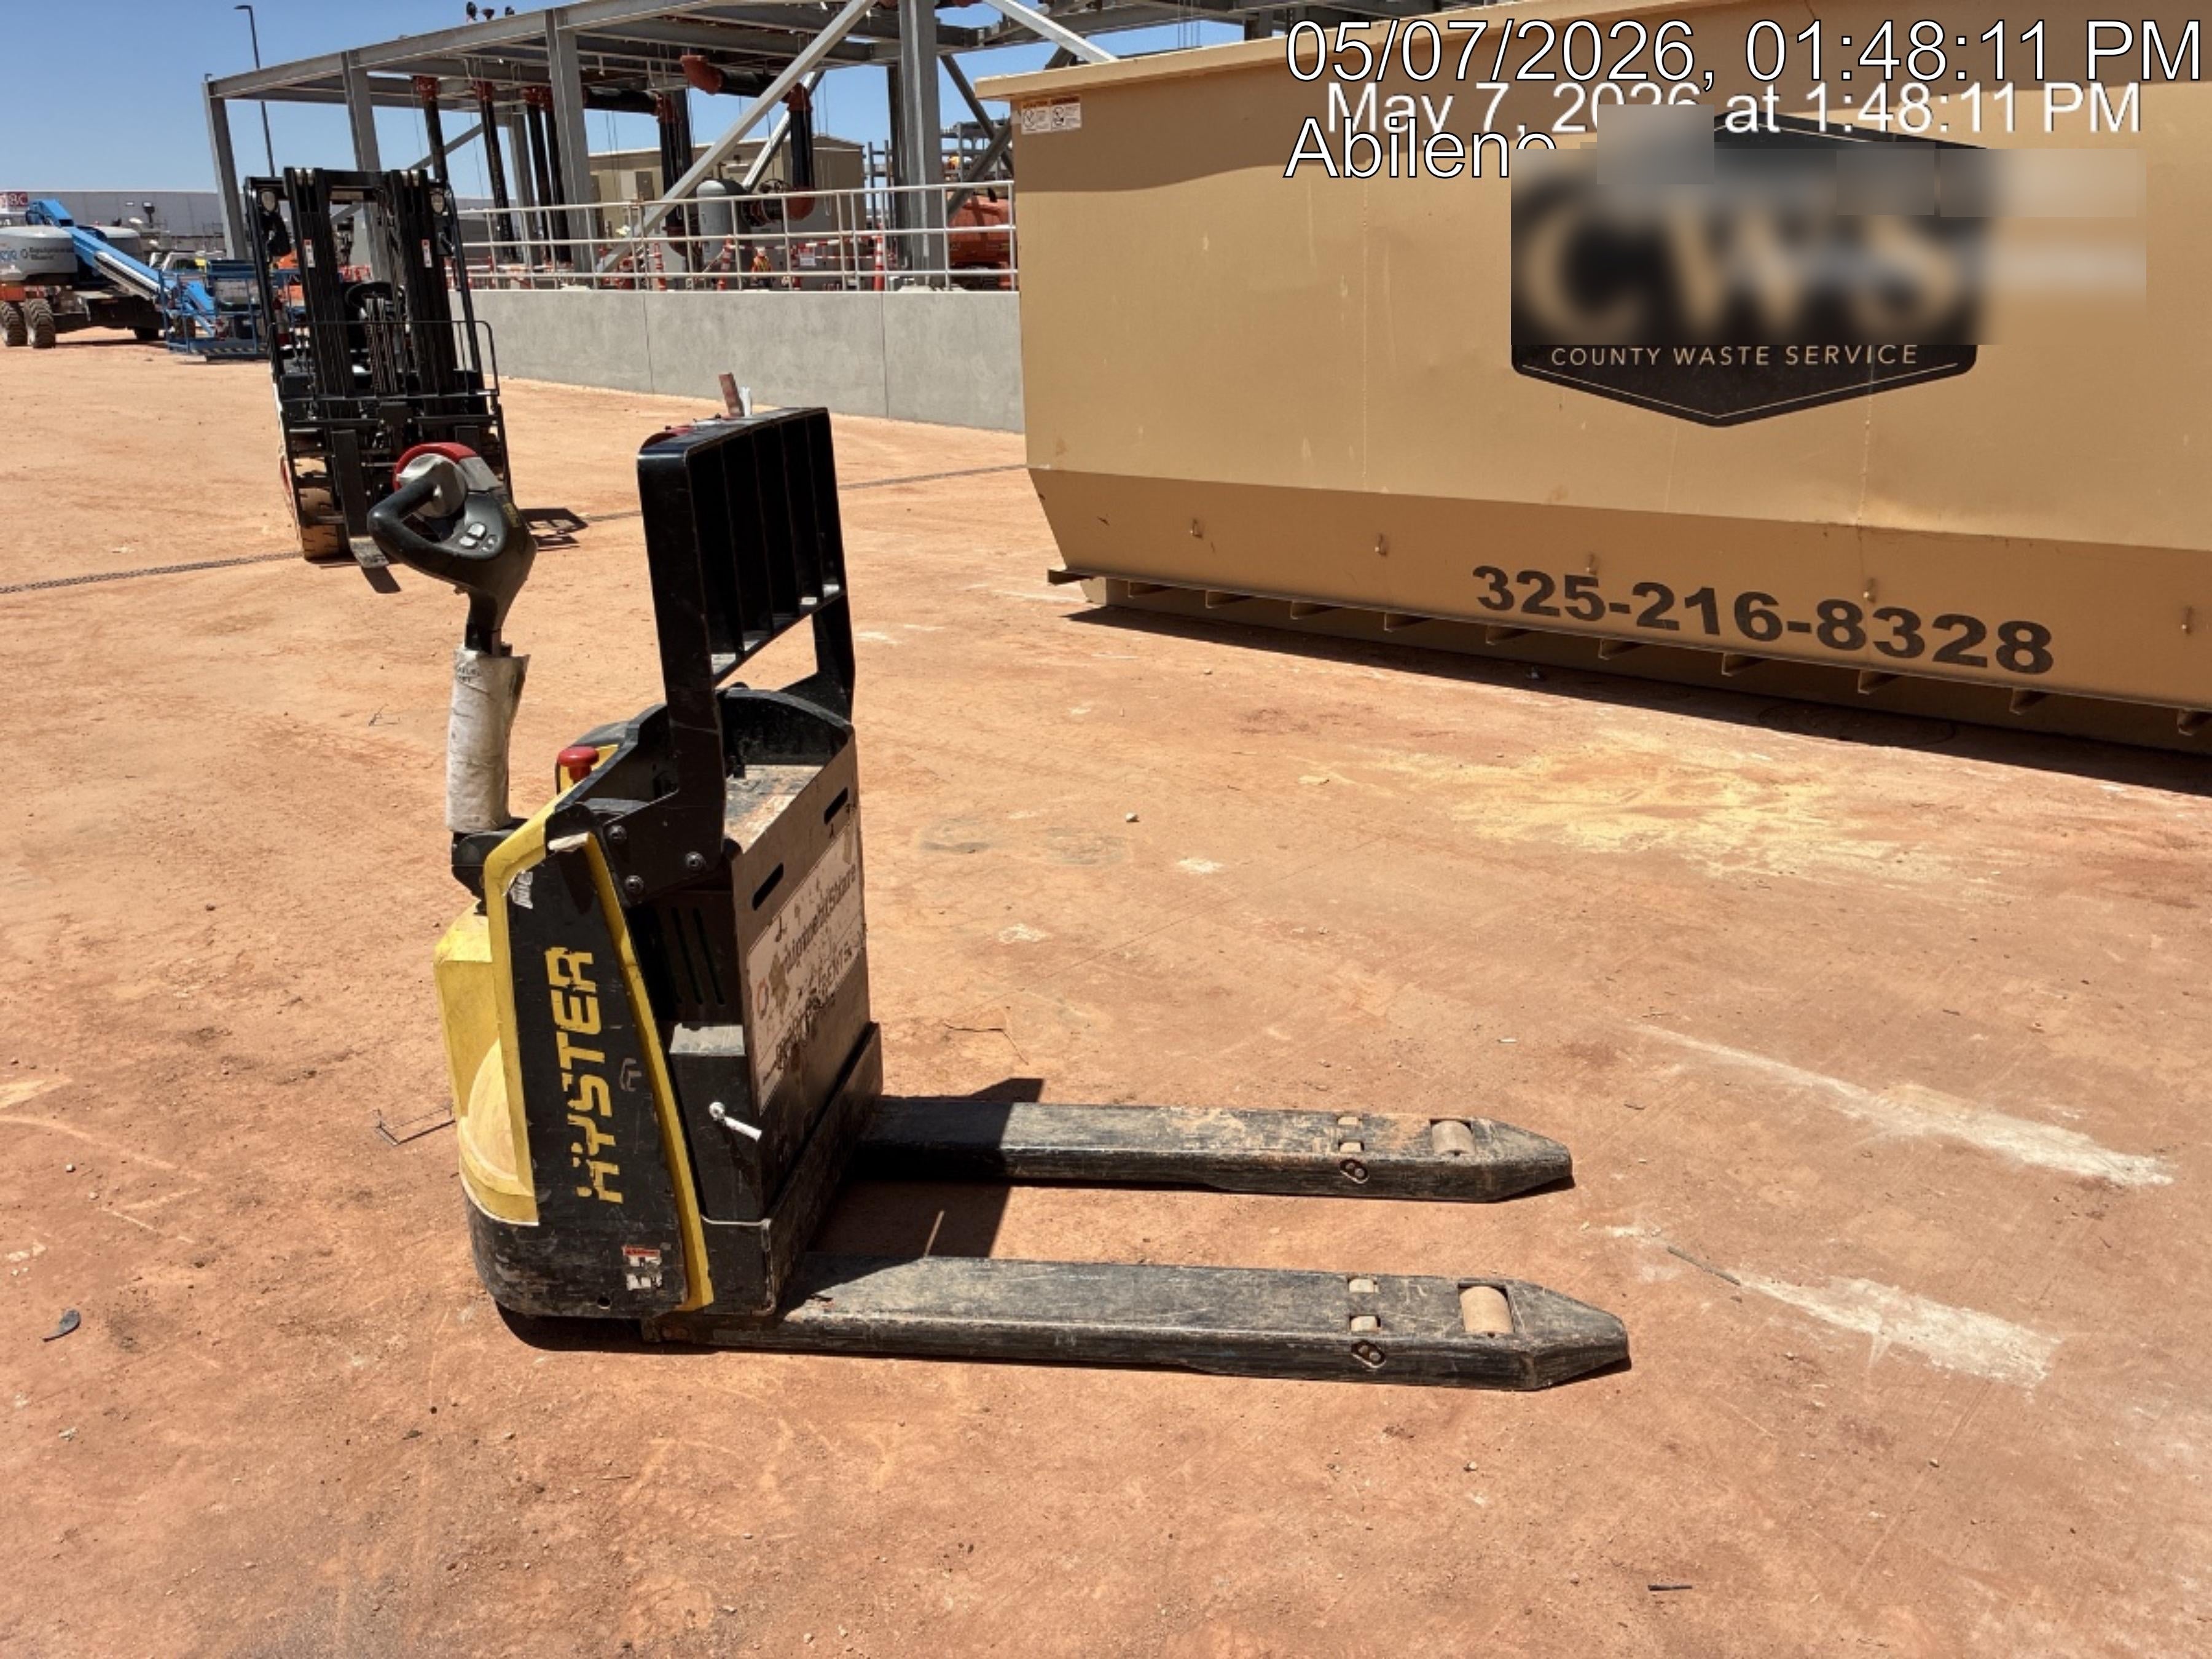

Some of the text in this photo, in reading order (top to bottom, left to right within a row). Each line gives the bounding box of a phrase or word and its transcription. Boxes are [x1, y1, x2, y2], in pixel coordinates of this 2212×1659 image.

[1551, 344, 1918, 366] COUNTY WASTE SERVICE
[1473, 563, 2054, 675] 325-216-8328
[544, 946, 623, 1204] HYSTER
